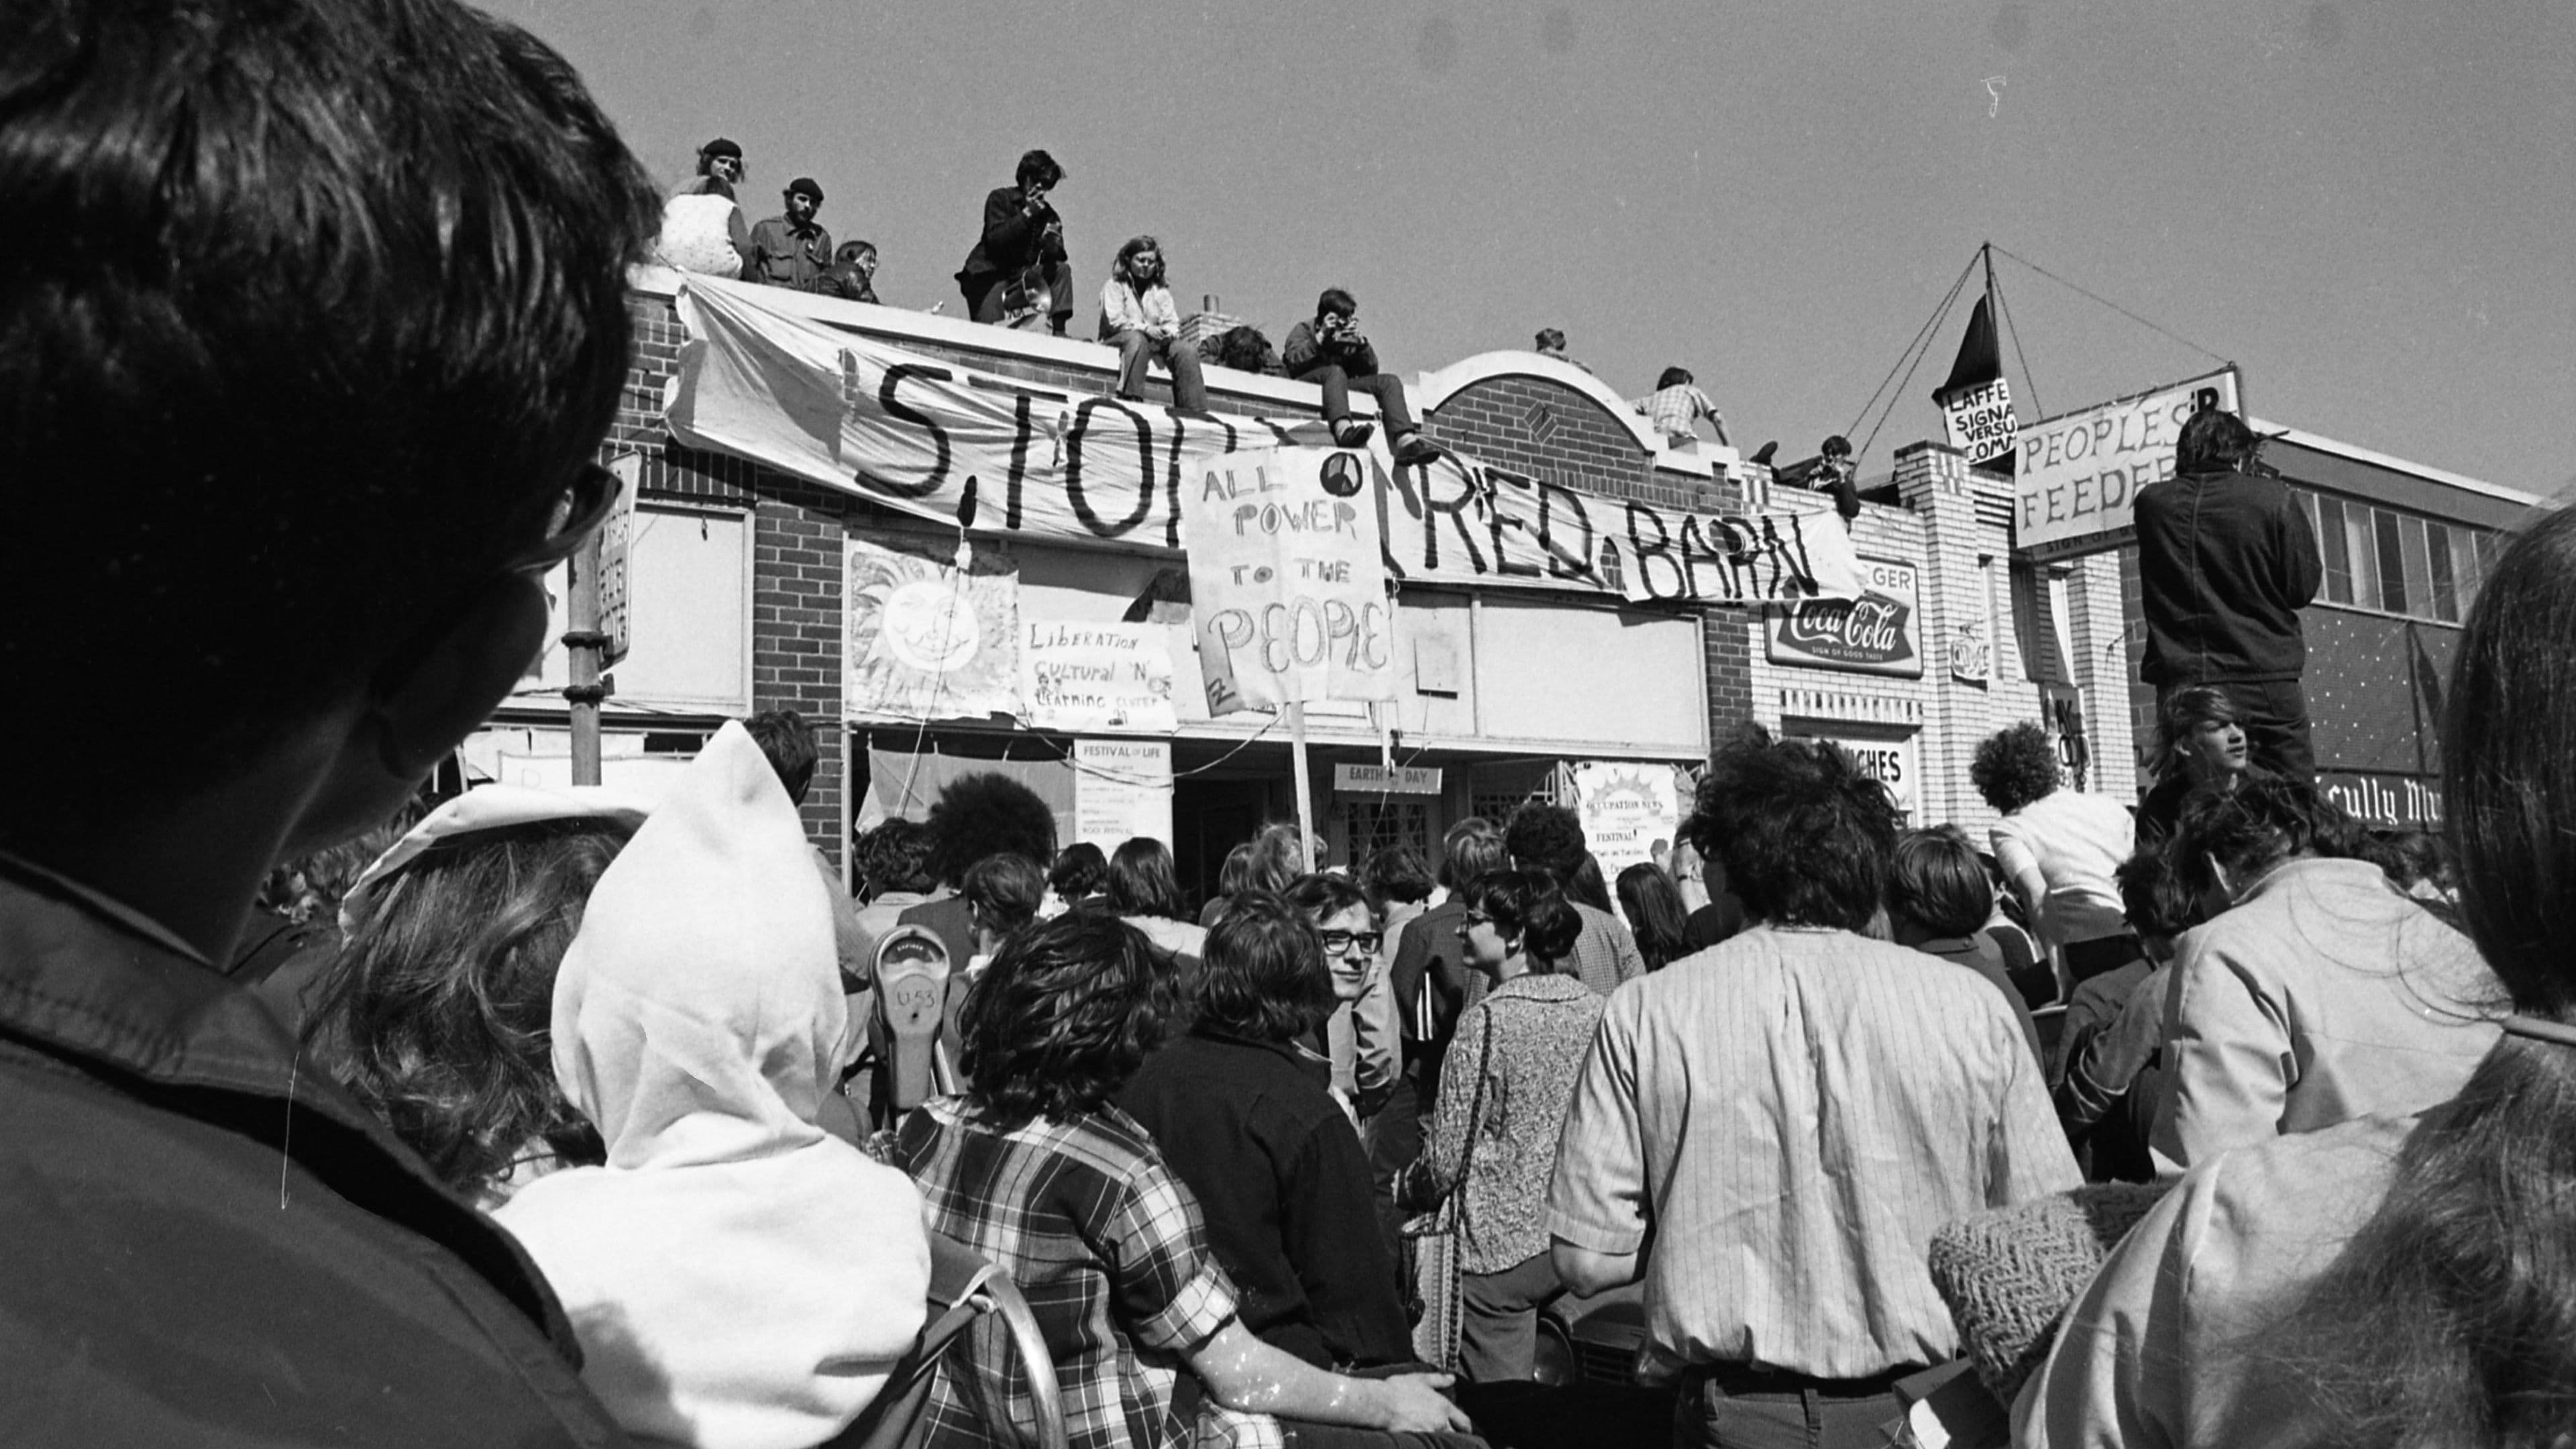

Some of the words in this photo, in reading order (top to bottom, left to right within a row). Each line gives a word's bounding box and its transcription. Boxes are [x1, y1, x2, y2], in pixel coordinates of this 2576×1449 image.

[1947, 382, 2008, 413] LAFFE
[1955, 403, 2014, 432] SIGNA
[1965, 419, 2015, 442] VERSU
[853, 363, 1236, 549] STOP
[1419, 444, 1607, 589] RED
[1625, 503, 1820, 600] BARN
[1203, 465, 1287, 502] ALL
[1232, 499, 1357, 539] POWER
[2046, 536, 2083, 553] SIGN
[1230, 564, 1274, 586] TO
[1293, 555, 1351, 583] THE
[1872, 566, 1911, 590] GER
[1208, 594, 1387, 679] PEOPLE
[1083, 745, 1130, 757] FESTIVAL
[1142, 747, 1160, 758] LIFE
[1349, 766, 1383, 782] EARTH
[1405, 769, 1428, 784] DAY
[2314, 775, 2399, 826] cully
